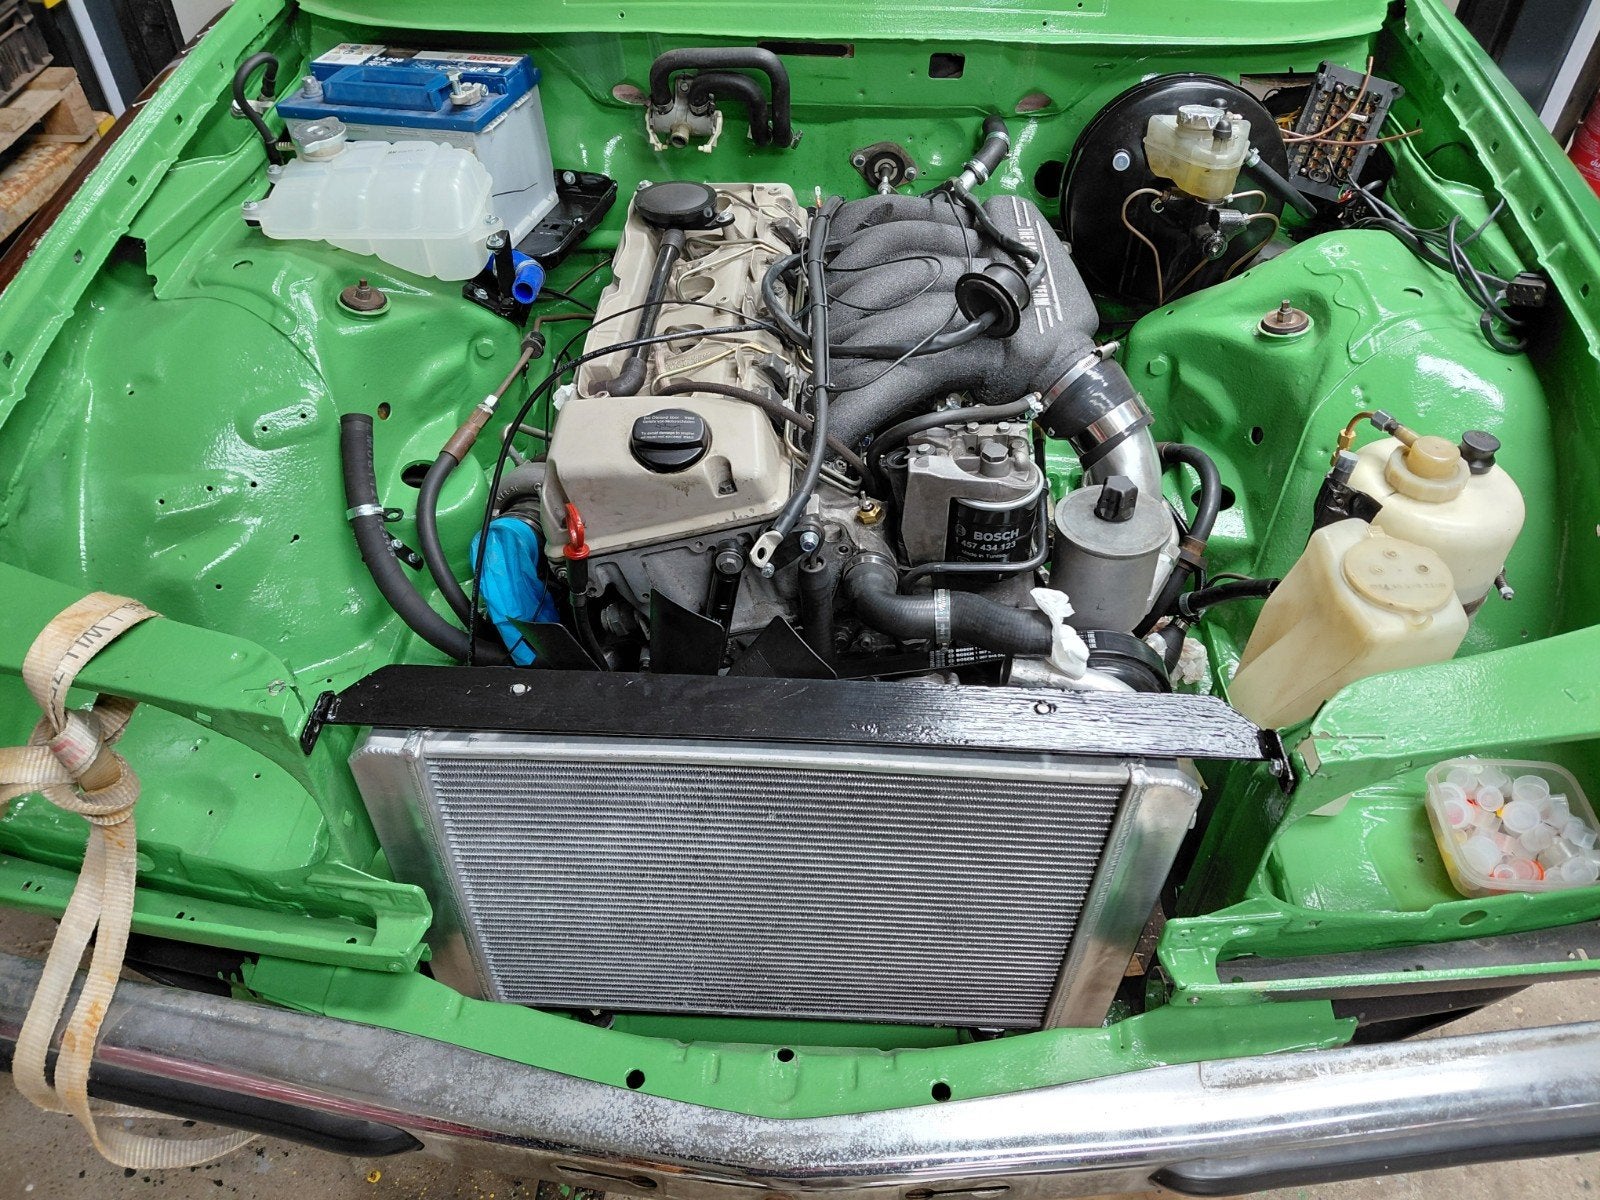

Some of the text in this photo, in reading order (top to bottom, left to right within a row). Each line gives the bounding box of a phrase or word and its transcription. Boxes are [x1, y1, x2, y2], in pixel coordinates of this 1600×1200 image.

[467, 54, 515, 63] BOSCH
[973, 528, 1019, 541] BOSCH
[961, 540, 978, 549] 457
[1000, 540, 1016, 551] 123
